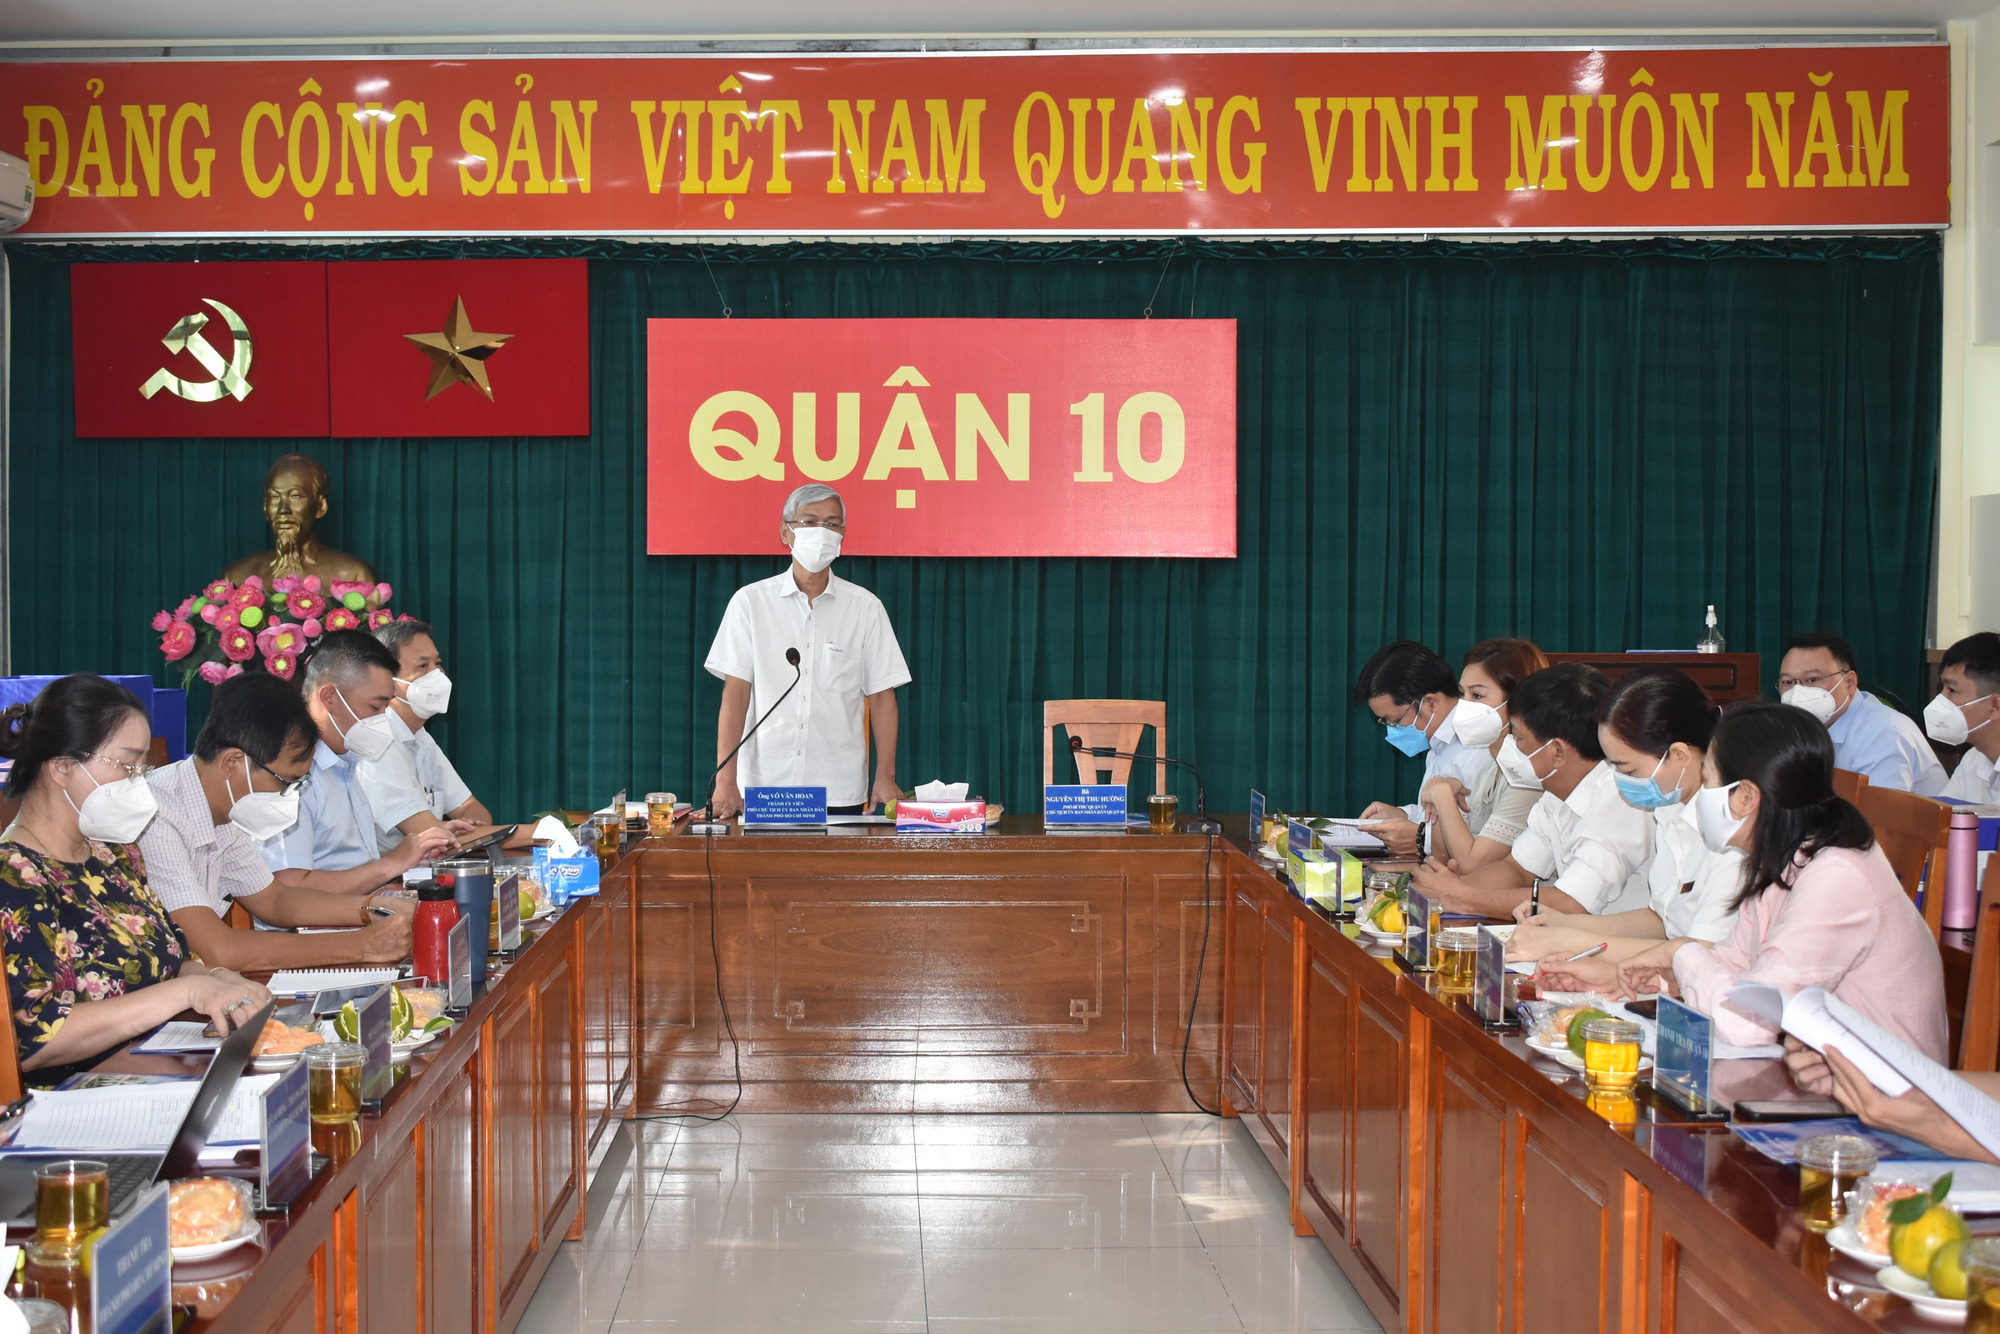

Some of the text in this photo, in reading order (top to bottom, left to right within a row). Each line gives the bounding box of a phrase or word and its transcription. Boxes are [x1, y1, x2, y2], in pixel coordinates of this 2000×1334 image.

[23, 67, 1909, 220] ĐẢNG CỘNG SẢN VIỆT NAM QUANG VINH MUÔN NĂM
[689, 366, 1186, 509] QUẬN 10
[757, 792, 770, 800] Ông
